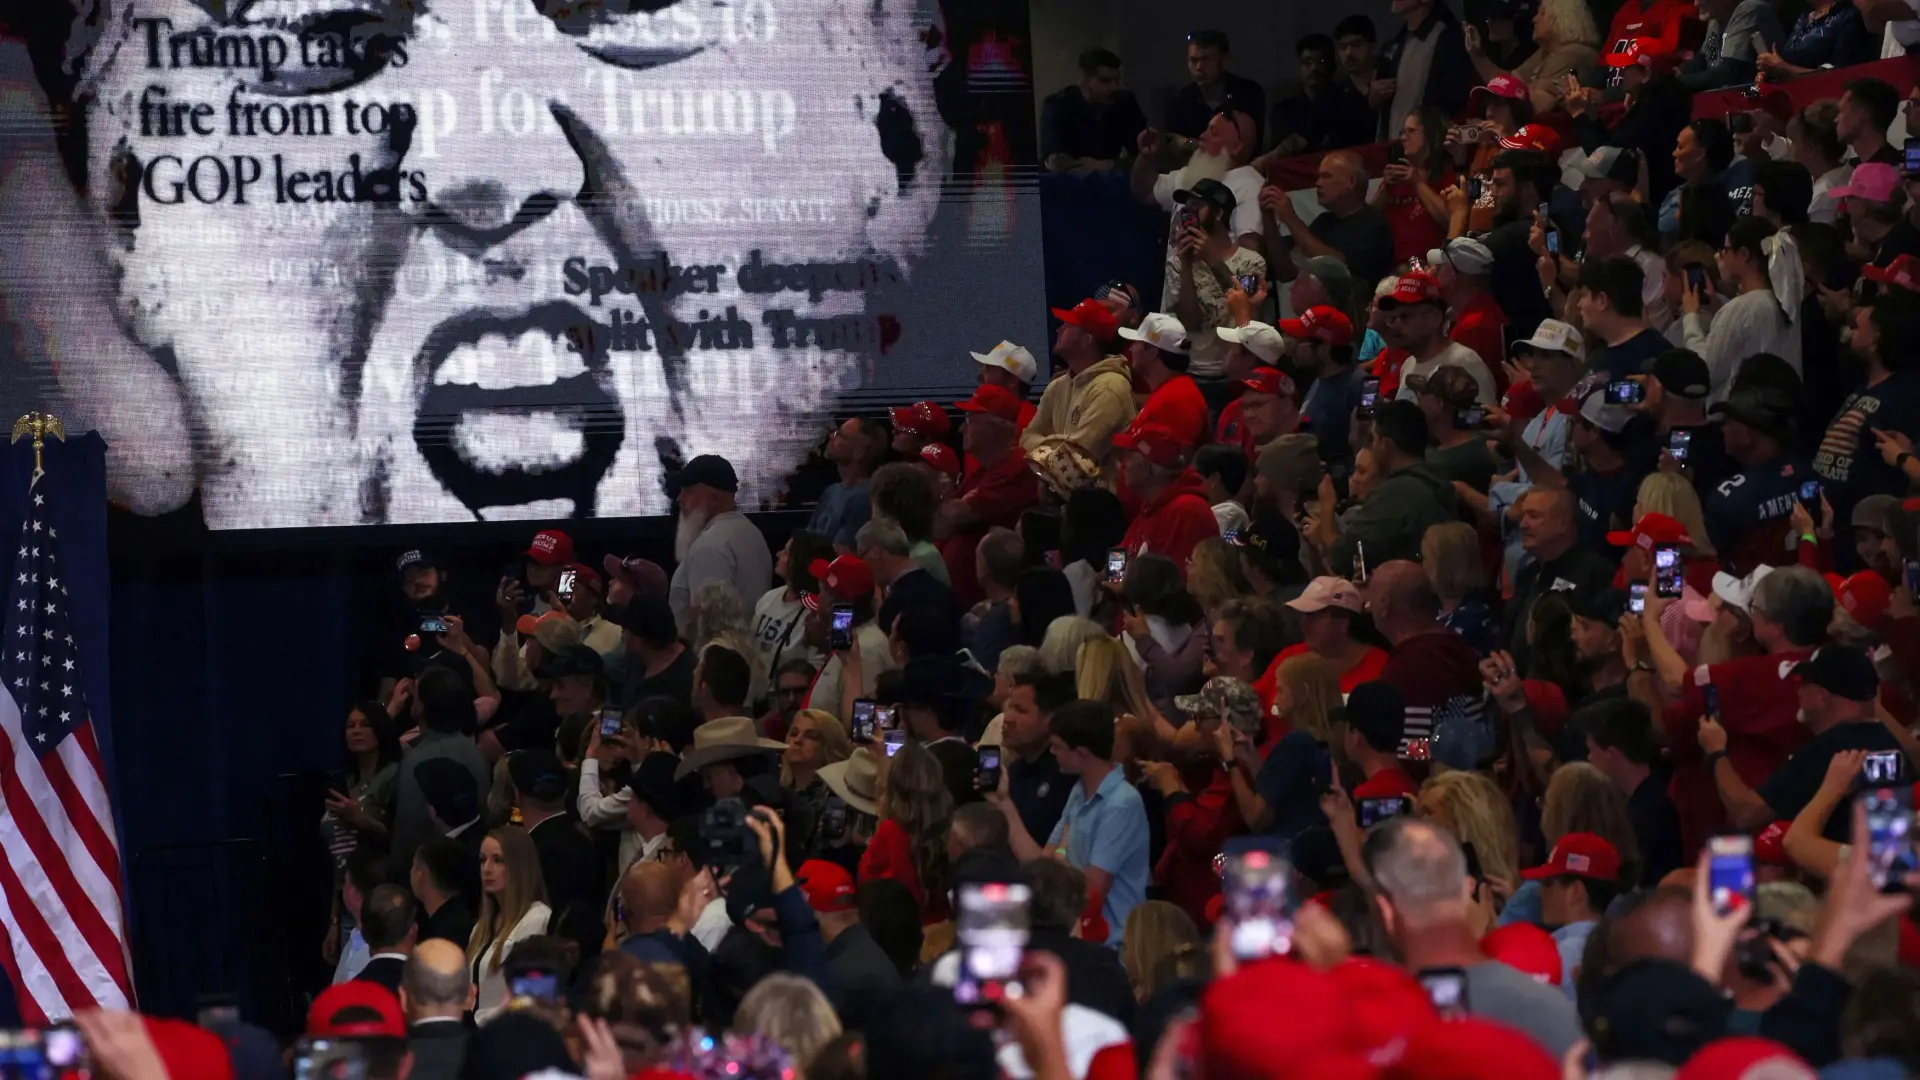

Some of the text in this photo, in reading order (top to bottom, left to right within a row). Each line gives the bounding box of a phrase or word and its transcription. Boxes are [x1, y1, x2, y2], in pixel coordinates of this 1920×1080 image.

[133, 17, 287, 82] Trump
[300, 18, 408, 69] tas
[139, 84, 216, 137] fire
[228, 80, 331, 136] from
[344, 98, 418, 154] top
[479, 68, 567, 136] for
[583, 67, 797, 156] Trump
[142, 153, 428, 205] GOP leadrs
[1716, 473, 1746, 498] 2
[754, 614, 794, 647] USA
